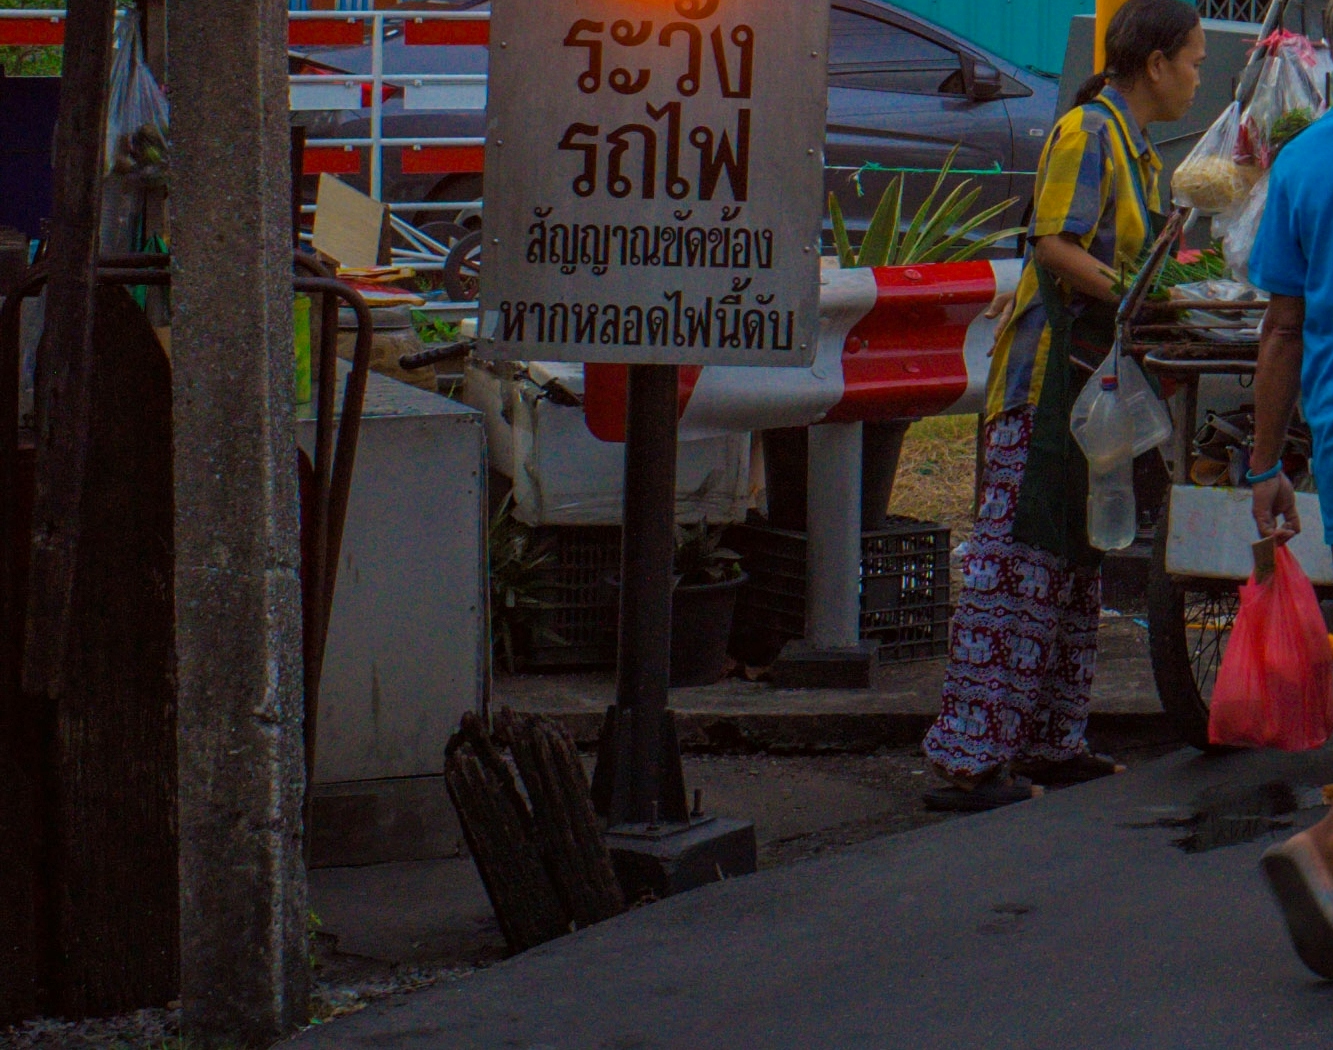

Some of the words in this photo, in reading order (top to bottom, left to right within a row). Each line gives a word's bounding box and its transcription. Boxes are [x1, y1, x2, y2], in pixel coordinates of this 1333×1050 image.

[558, 102, 750, 202] รถไฟ
[525, 206, 775, 276] สัญญาณขัดข้อง
[499, 277, 795, 352] หากหลอดไฟนี้ดับ
